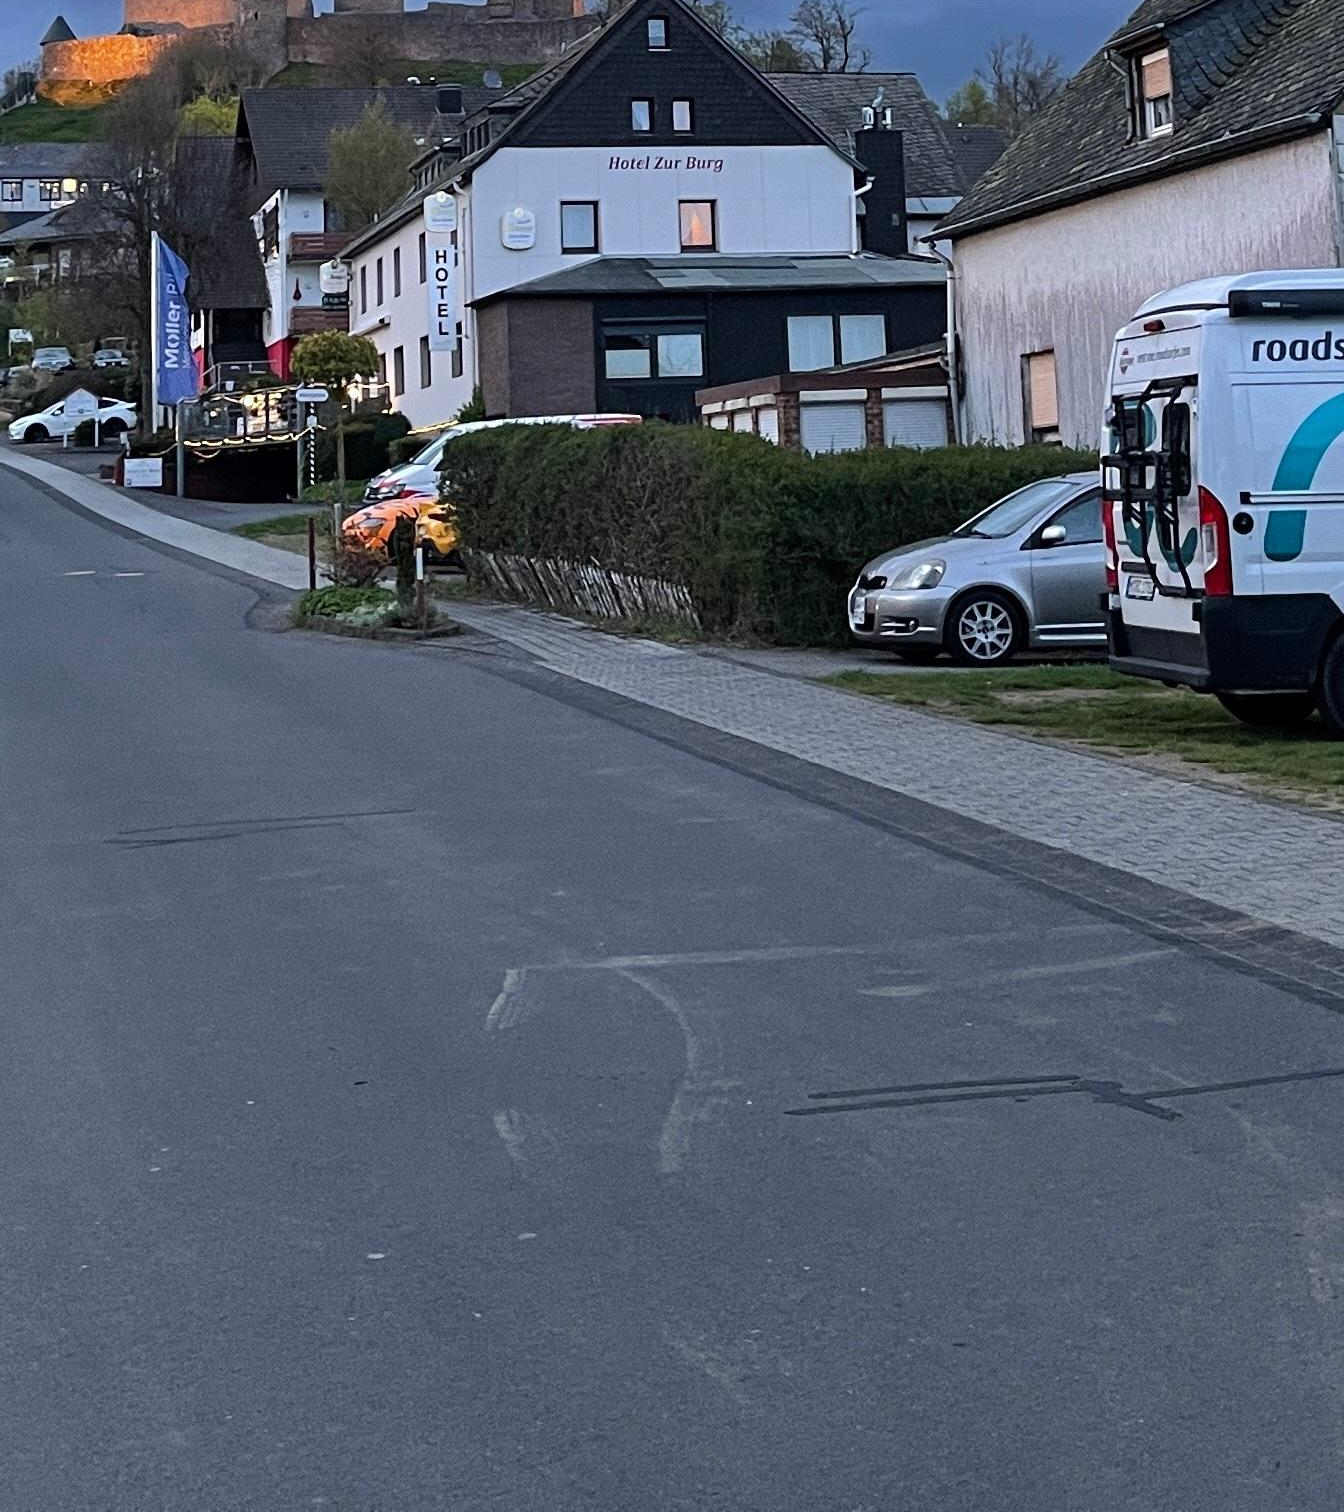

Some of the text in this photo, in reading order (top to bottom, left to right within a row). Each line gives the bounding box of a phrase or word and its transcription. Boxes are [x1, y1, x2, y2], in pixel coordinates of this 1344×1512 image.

[609, 156, 723, 173] Hotel Zur Burg
[435, 250, 449, 336] HOTEL
